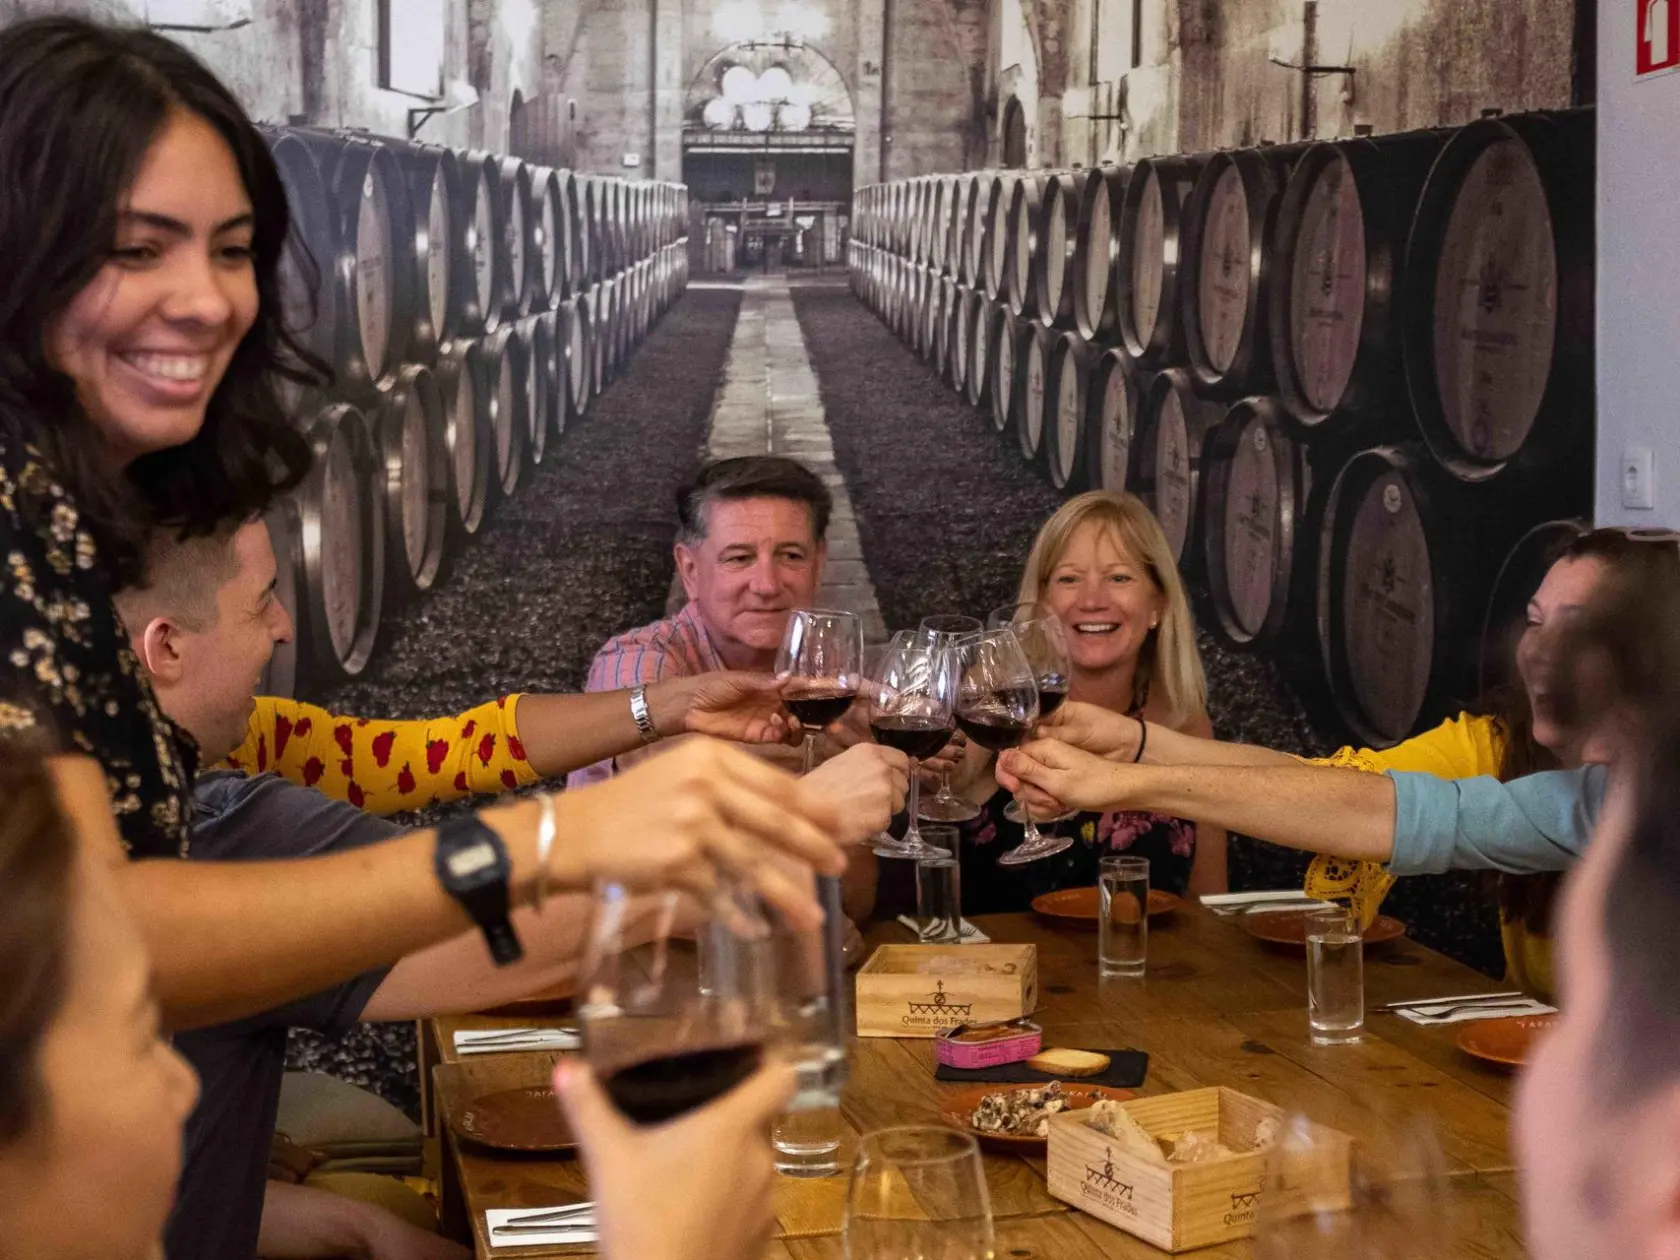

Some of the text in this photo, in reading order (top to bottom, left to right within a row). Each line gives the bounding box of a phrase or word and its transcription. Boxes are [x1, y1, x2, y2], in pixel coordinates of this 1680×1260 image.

[902, 1016, 931, 1025] Quinta
[933, 1016, 948, 1025] dos
[1223, 1211, 1256, 1226] Quinta
